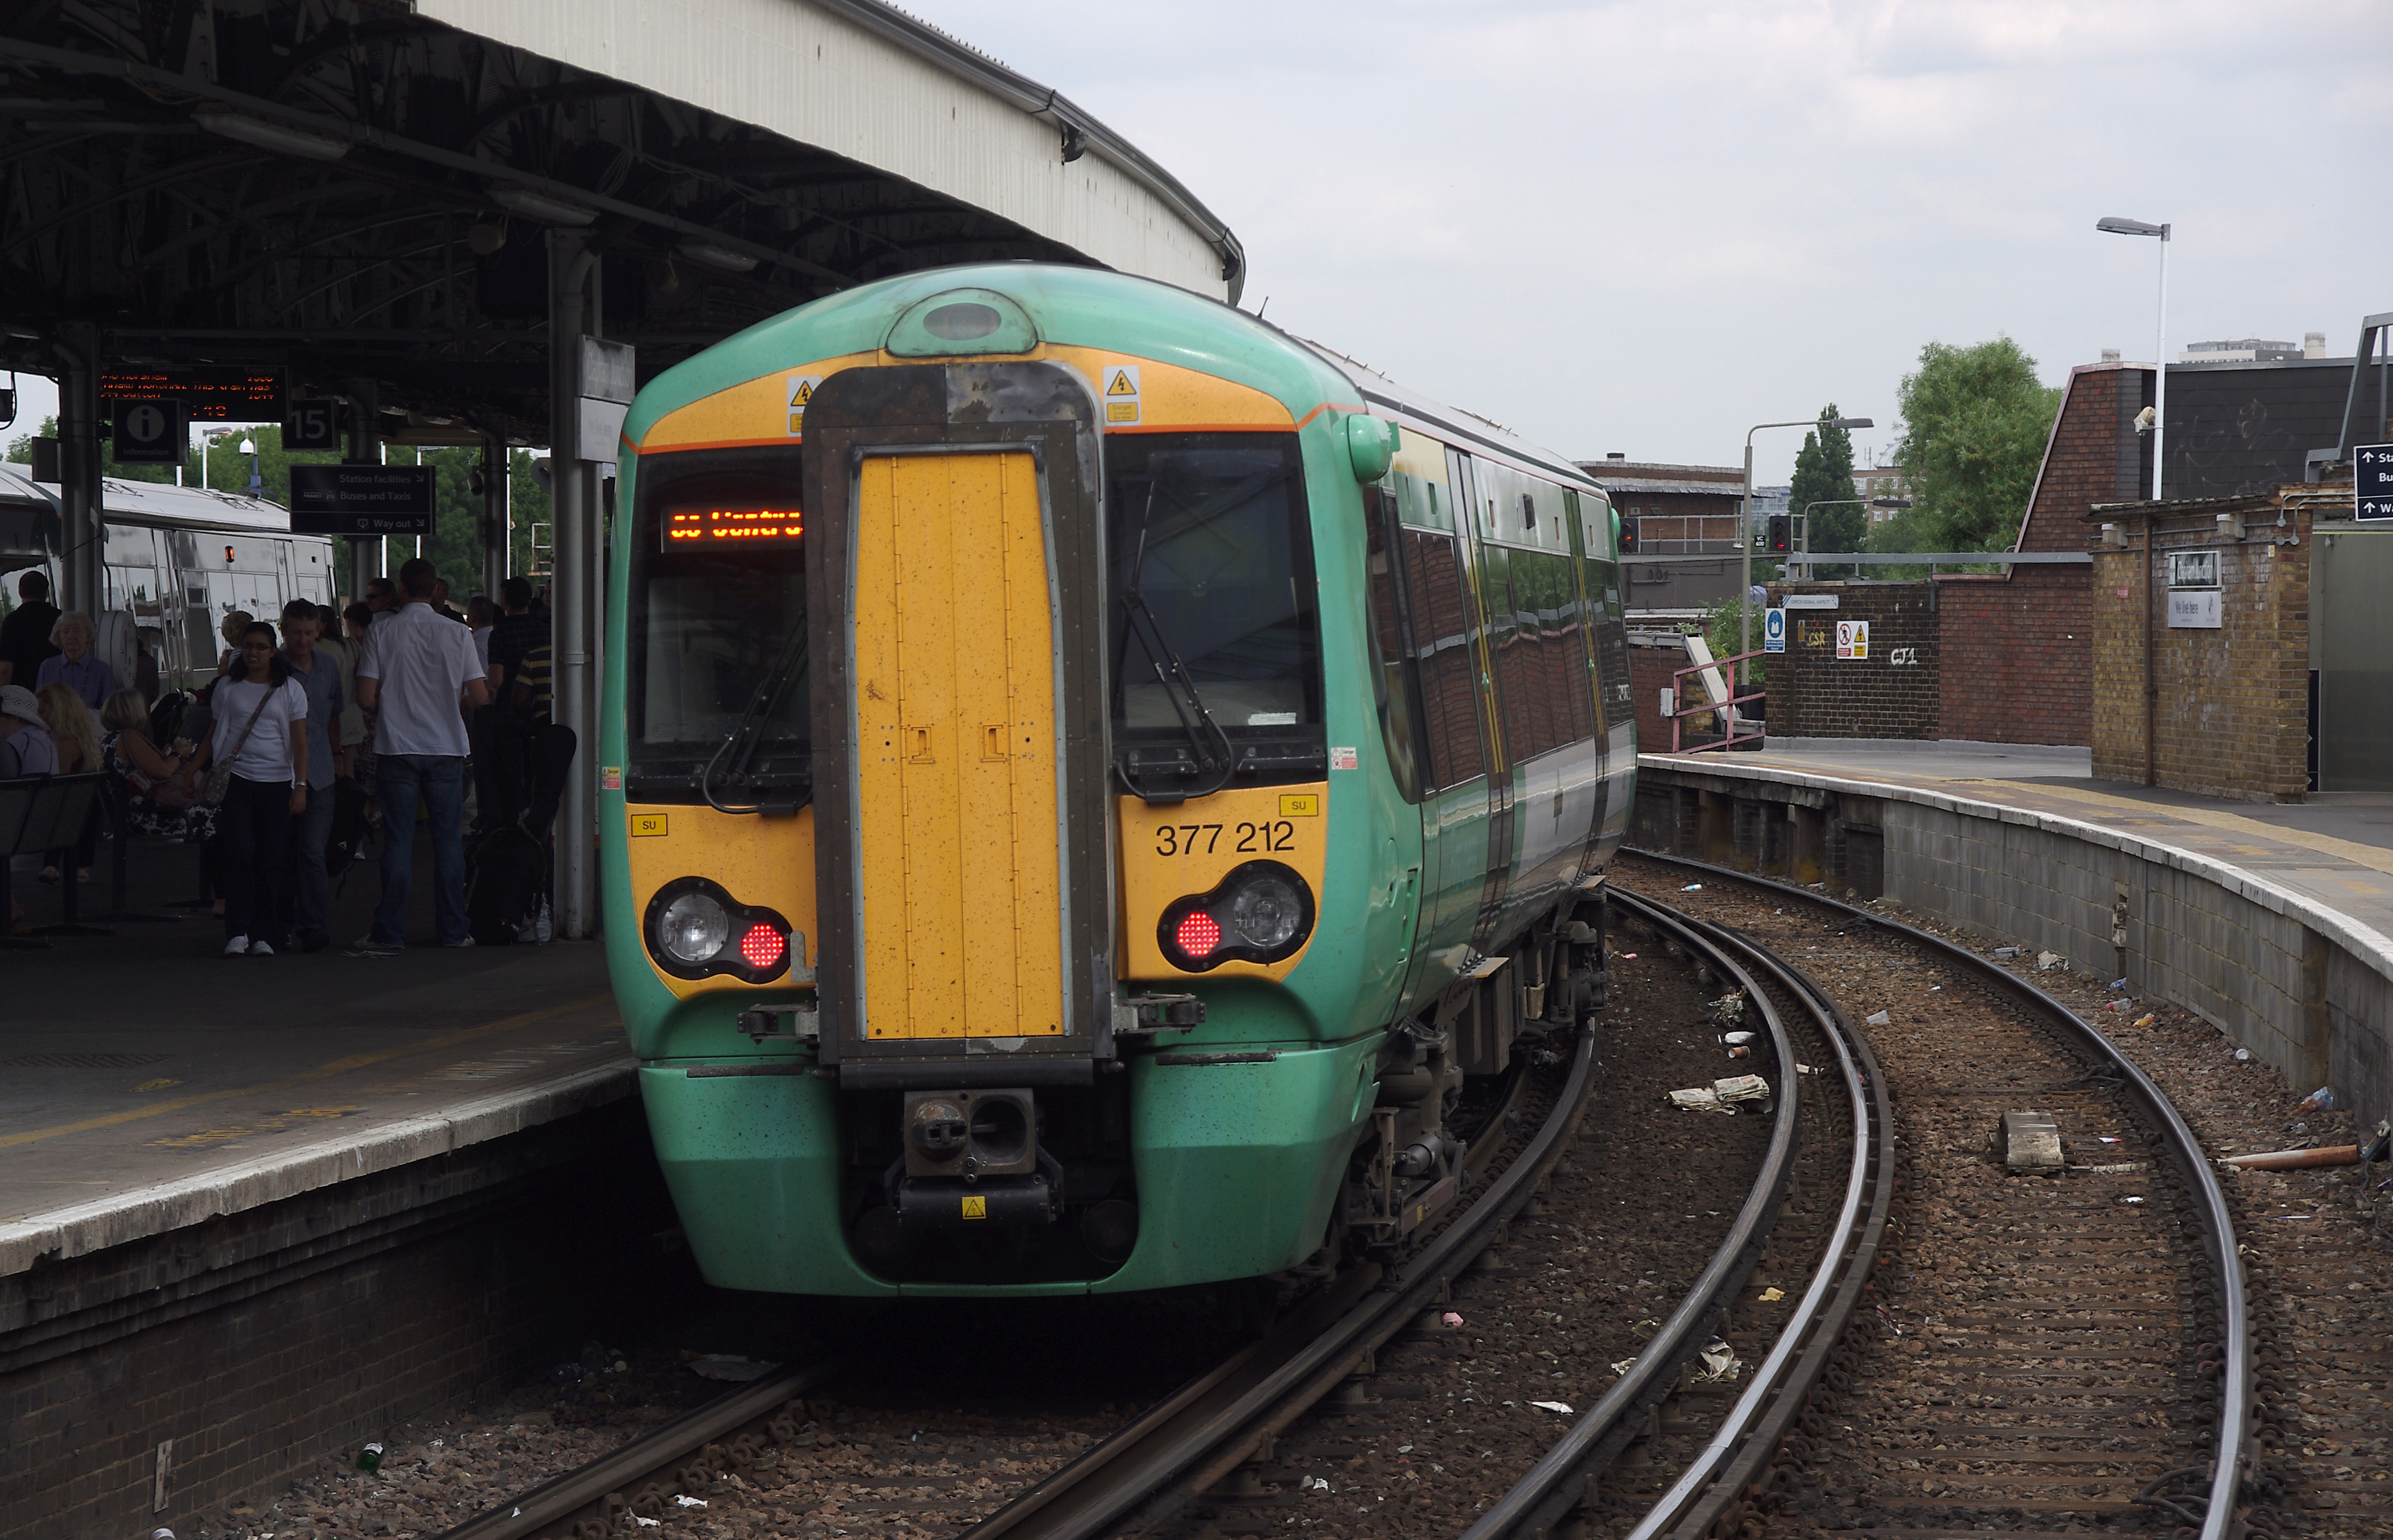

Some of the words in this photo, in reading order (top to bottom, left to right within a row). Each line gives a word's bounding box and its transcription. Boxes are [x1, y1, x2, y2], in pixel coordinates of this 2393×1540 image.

[291, 410, 326, 439] 15
[124, 448, 168, 456] Information
[2379, 452, 2393, 463] St
[339, 474, 372, 484] Station
[374, 474, 411, 484] facilities
[340, 491, 366, 501] Buses
[369, 491, 385, 501] and
[387, 491, 411, 501] Taxis
[2379, 503, 2393, 513] W
[374, 520, 393, 529] Way
[396, 520, 411, 528] out
[2175, 601, 2182, 614] We
[2189, 601, 2198, 614] here
[1292, 800, 1307, 810] SU
[642, 821, 656, 830] SU
[1156, 824, 1223, 857] 377
[1236, 820, 1295, 853] 212
